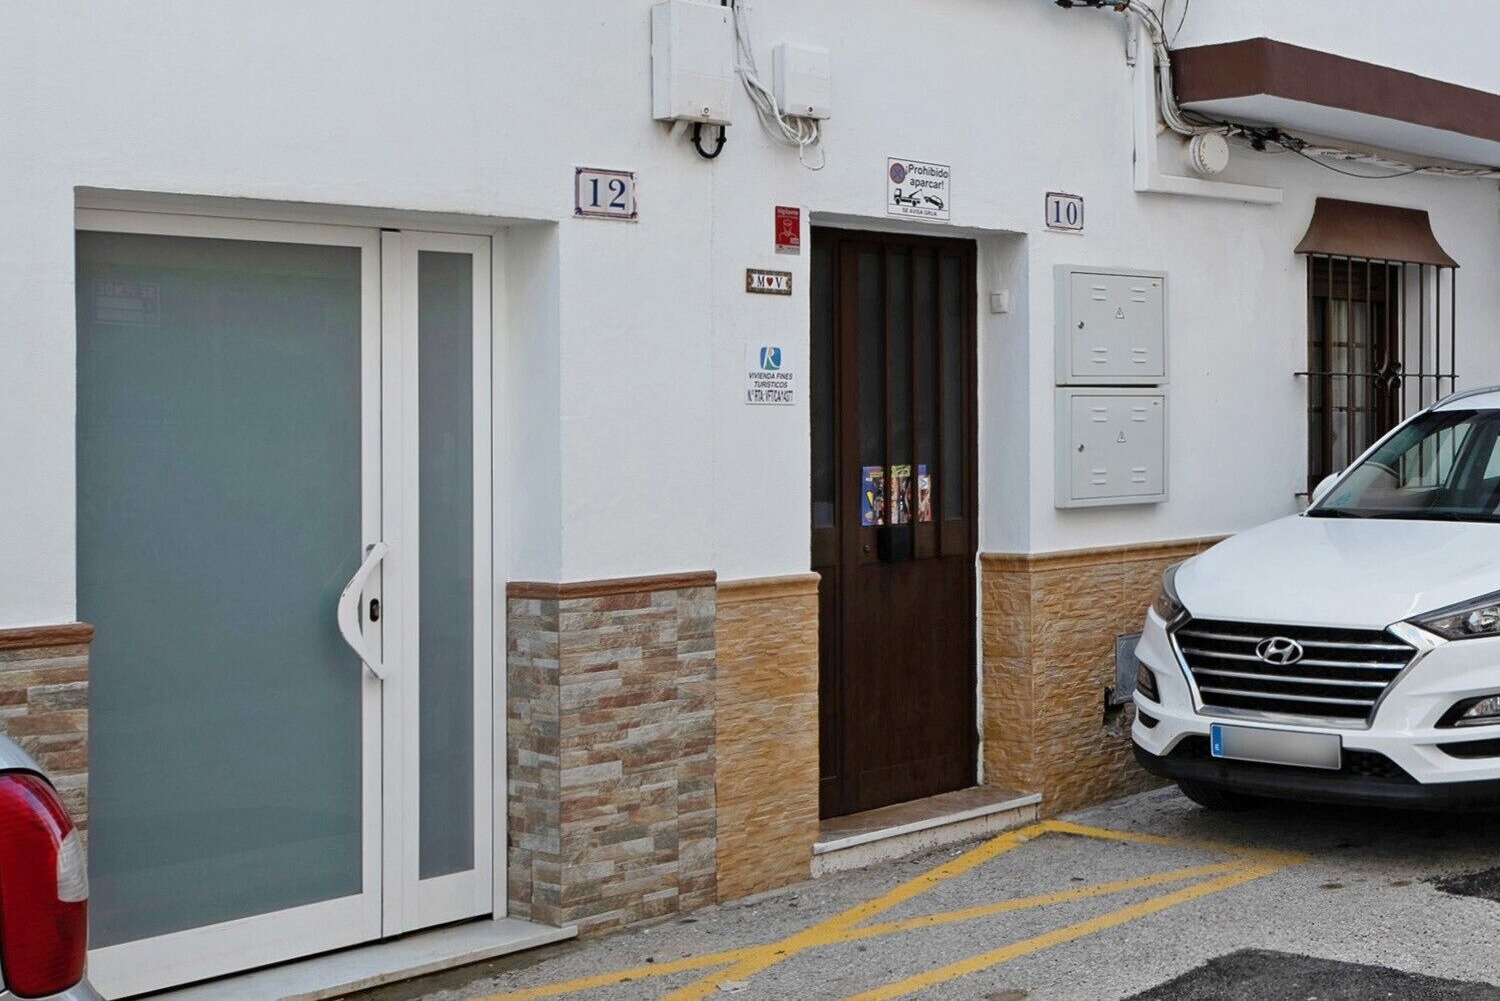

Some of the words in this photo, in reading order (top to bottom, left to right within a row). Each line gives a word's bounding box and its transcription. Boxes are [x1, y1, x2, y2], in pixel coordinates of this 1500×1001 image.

[909, 178, 944, 190] aparcar!
[589, 178, 626, 210] 12
[1054, 200, 1078, 225] 10
[757, 275, 765, 287] M
[775, 276, 783, 289] V
[748, 372, 775, 380] VIVIENDA
